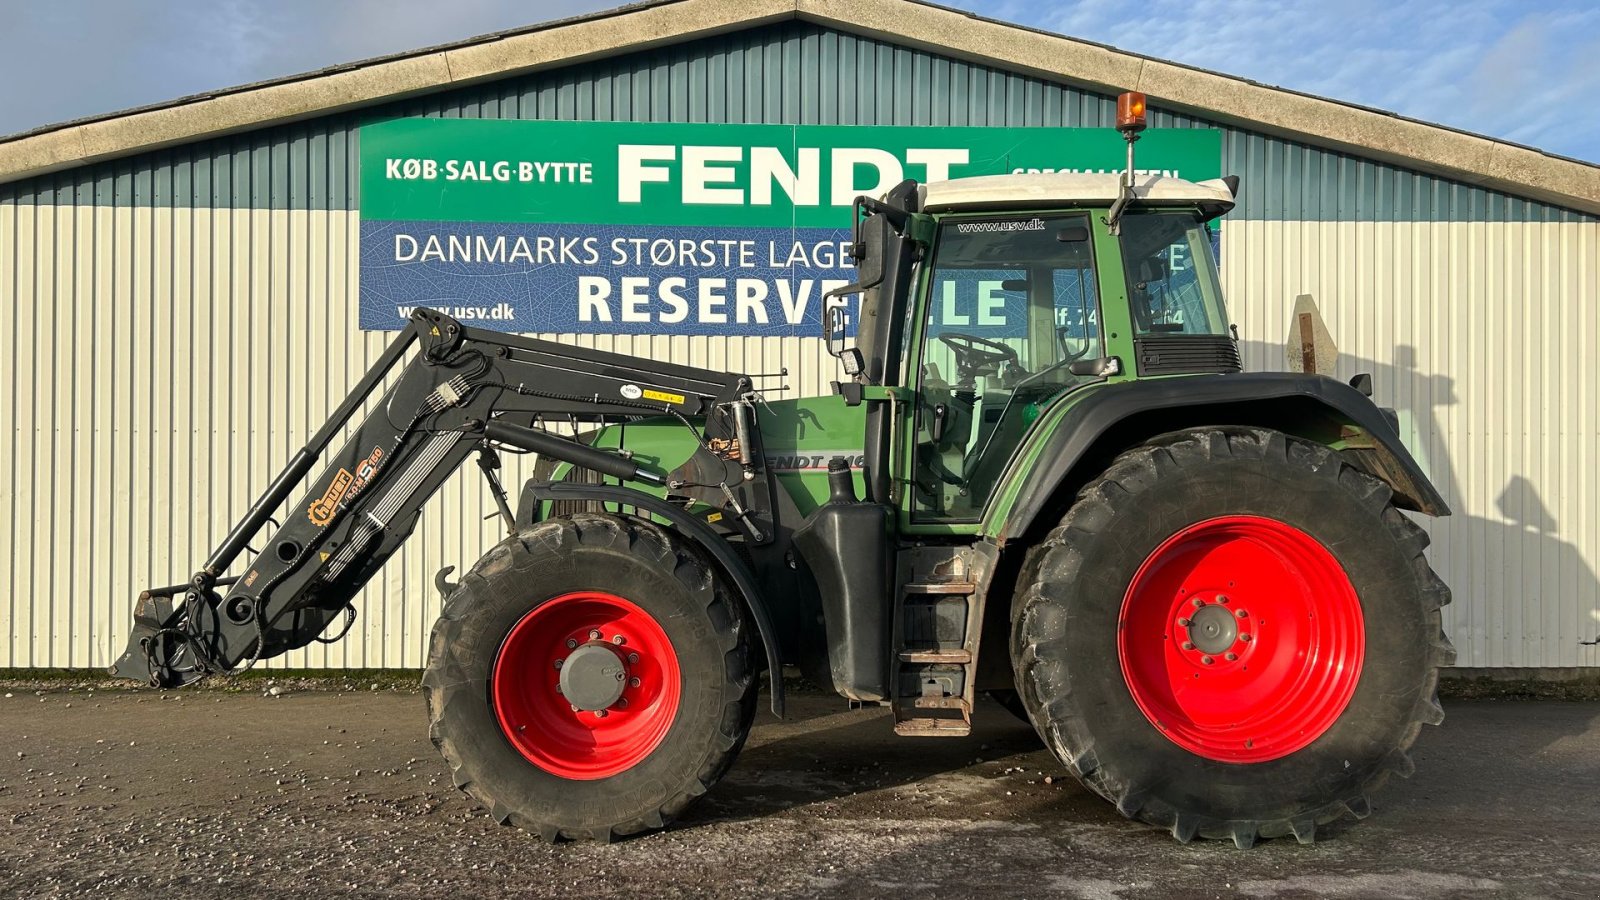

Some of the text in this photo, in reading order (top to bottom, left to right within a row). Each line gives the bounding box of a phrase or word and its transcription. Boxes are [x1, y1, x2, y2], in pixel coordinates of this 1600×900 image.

[618, 144, 970, 206] FENDT
[957, 218, 1046, 233] www.usv.dk
[394, 234, 856, 269] DANMARKS STØRSTE LAGE
[397, 303, 515, 320] ww.usv.dk
[766, 455, 825, 469] ENDT
